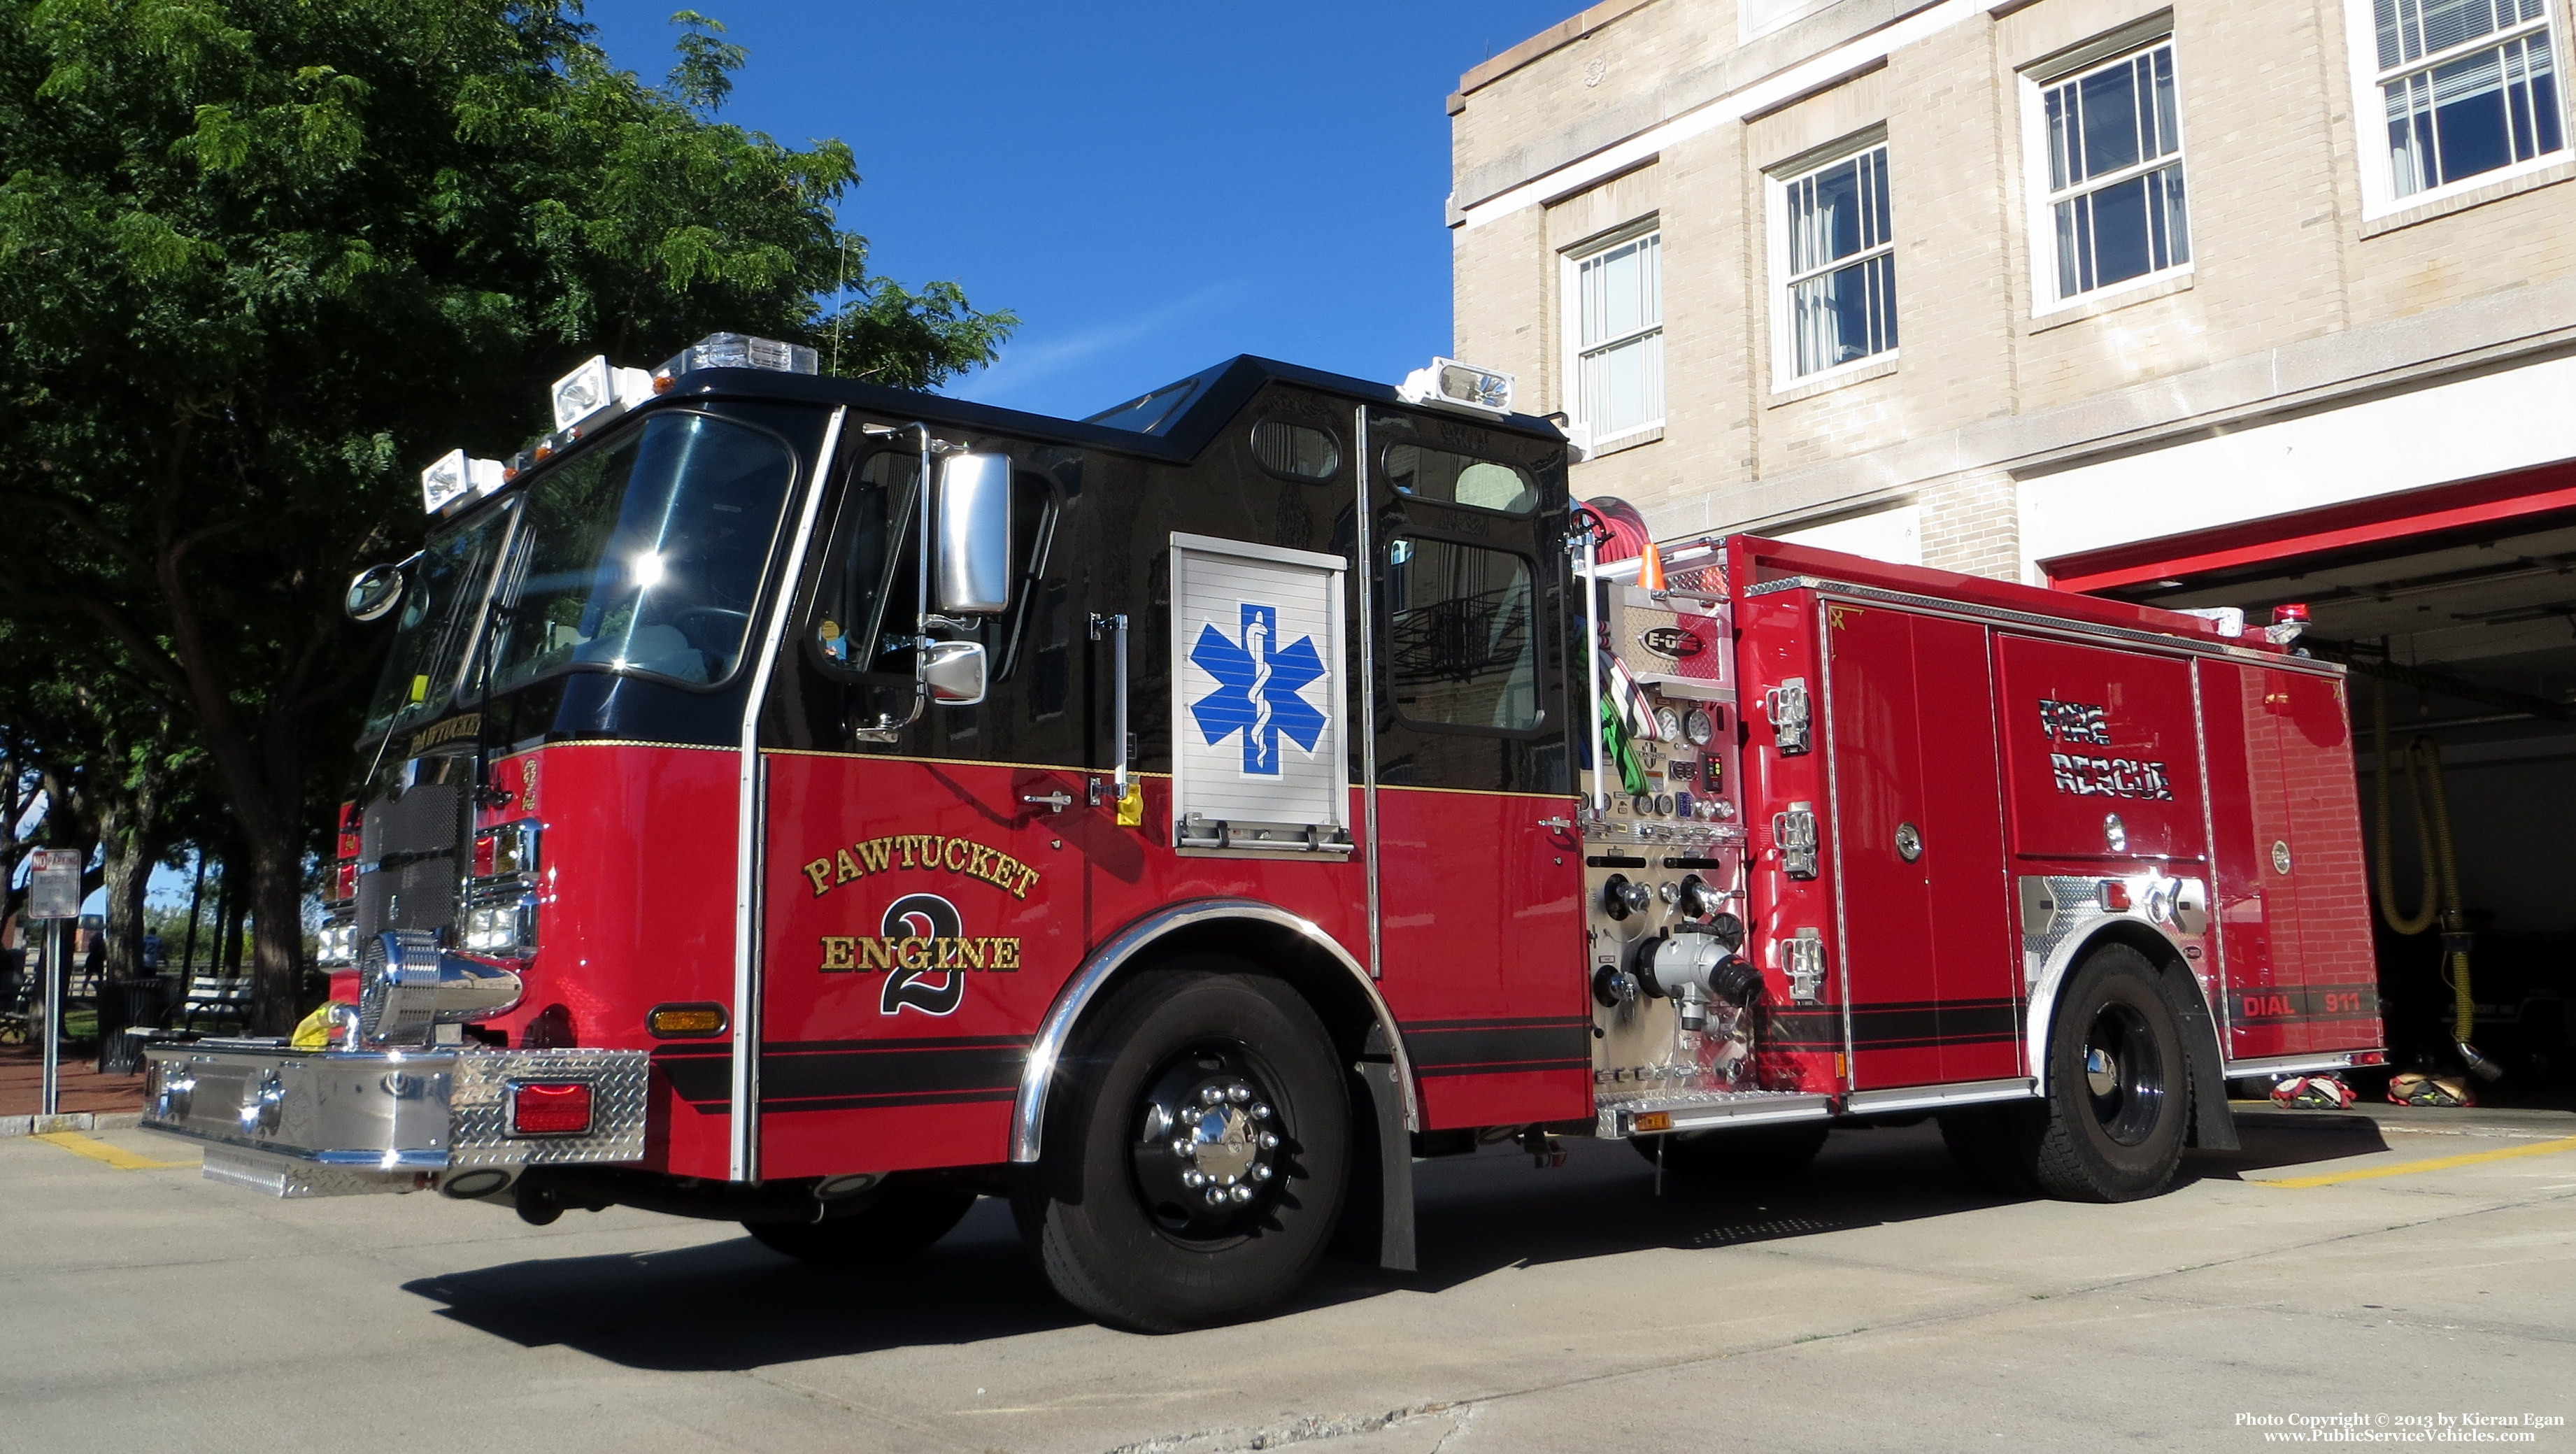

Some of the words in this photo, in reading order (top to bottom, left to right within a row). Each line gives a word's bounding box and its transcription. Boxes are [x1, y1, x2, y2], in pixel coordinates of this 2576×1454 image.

[408, 713, 482, 757] PAWTUCKE
[2039, 699, 2110, 744] FIRE
[522, 759, 536, 811] 2
[2050, 753, 2173, 801] RESCUE
[34, 855, 45, 867] NO
[802, 834, 1040, 899] PAWTUCKET
[820, 936, 1020, 972] ENGINE
[880, 892, 965, 1015] 2
[2243, 995, 2296, 1017] DIAL
[2325, 992, 2360, 1013] 911
